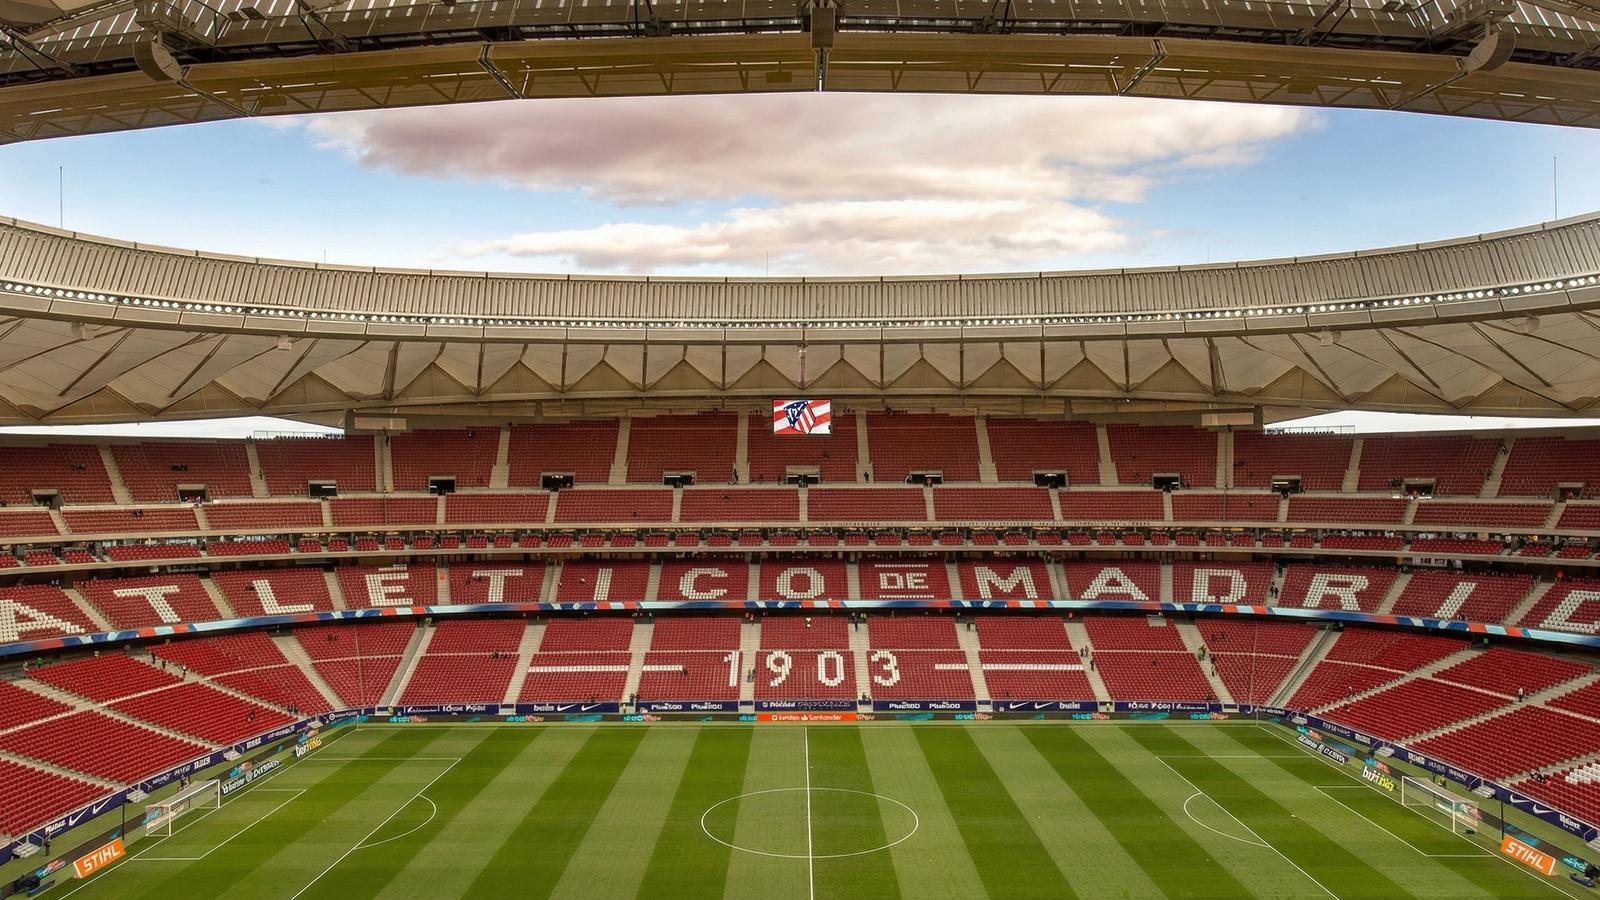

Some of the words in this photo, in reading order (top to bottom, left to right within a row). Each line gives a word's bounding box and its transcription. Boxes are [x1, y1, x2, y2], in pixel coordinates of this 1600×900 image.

[880, 572, 929, 590] DE
[723, 649, 900, 687] 1903
[83, 844, 121, 873] STIHL
[1506, 841, 1545, 870] STIHL
